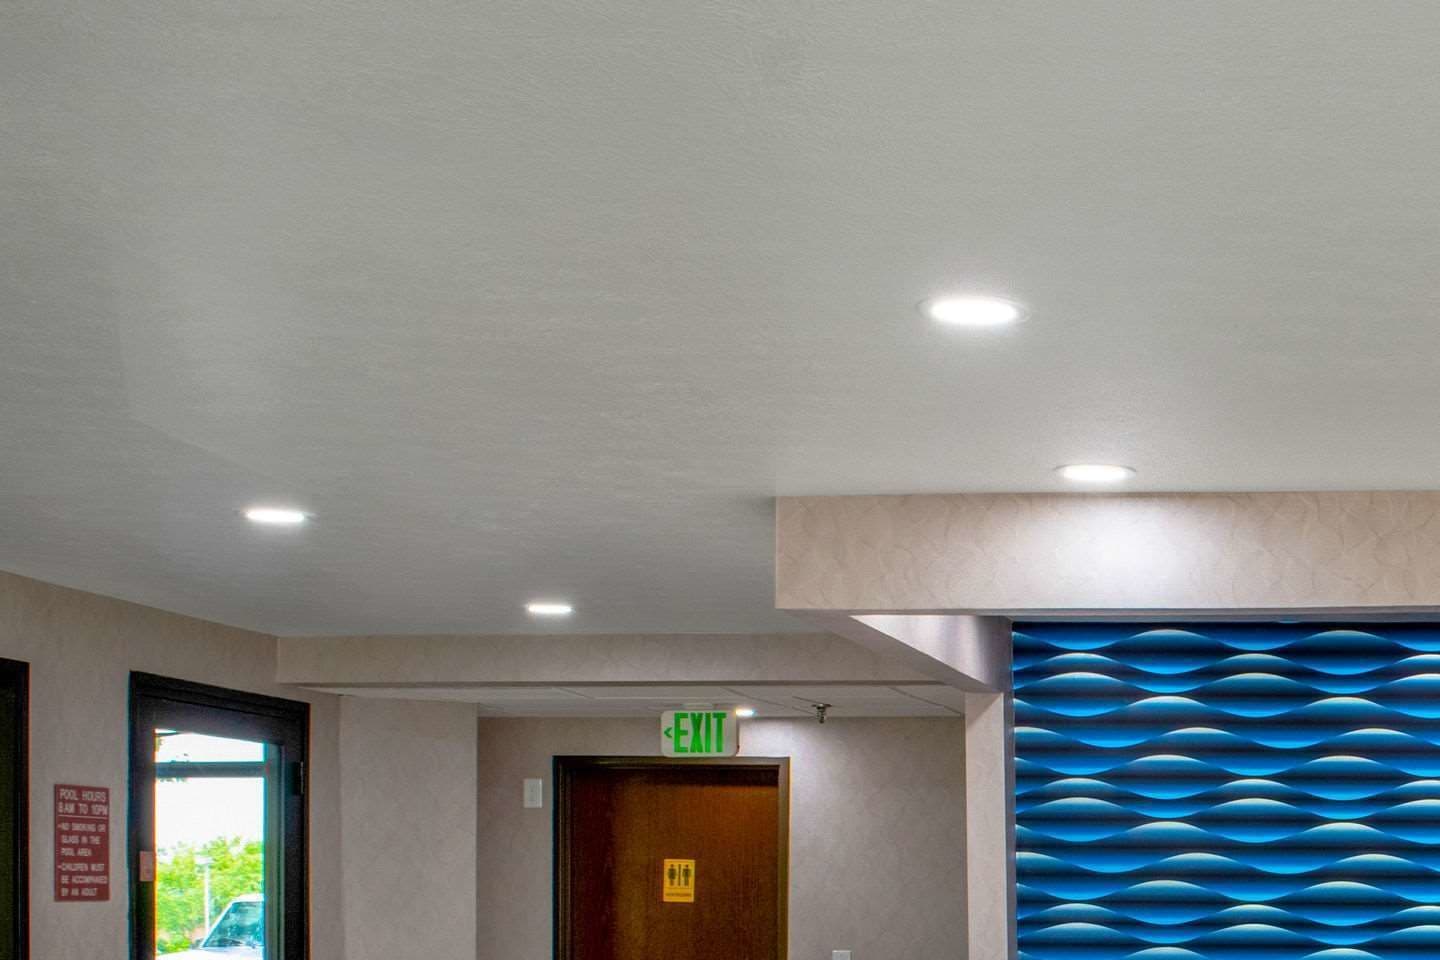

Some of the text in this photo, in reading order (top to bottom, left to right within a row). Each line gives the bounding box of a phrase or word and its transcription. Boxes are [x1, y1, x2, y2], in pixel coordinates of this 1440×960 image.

[674, 712, 727, 753] EXIT
[59, 788, 107, 803] POOL HOURS
[78, 802, 89, 815] TO
[90, 835, 101, 845] THE
[60, 847, 92, 857] POOL AREA
[61, 875, 70, 885] BE
[61, 887, 69, 897] BY
[71, 888, 80, 897] AN
